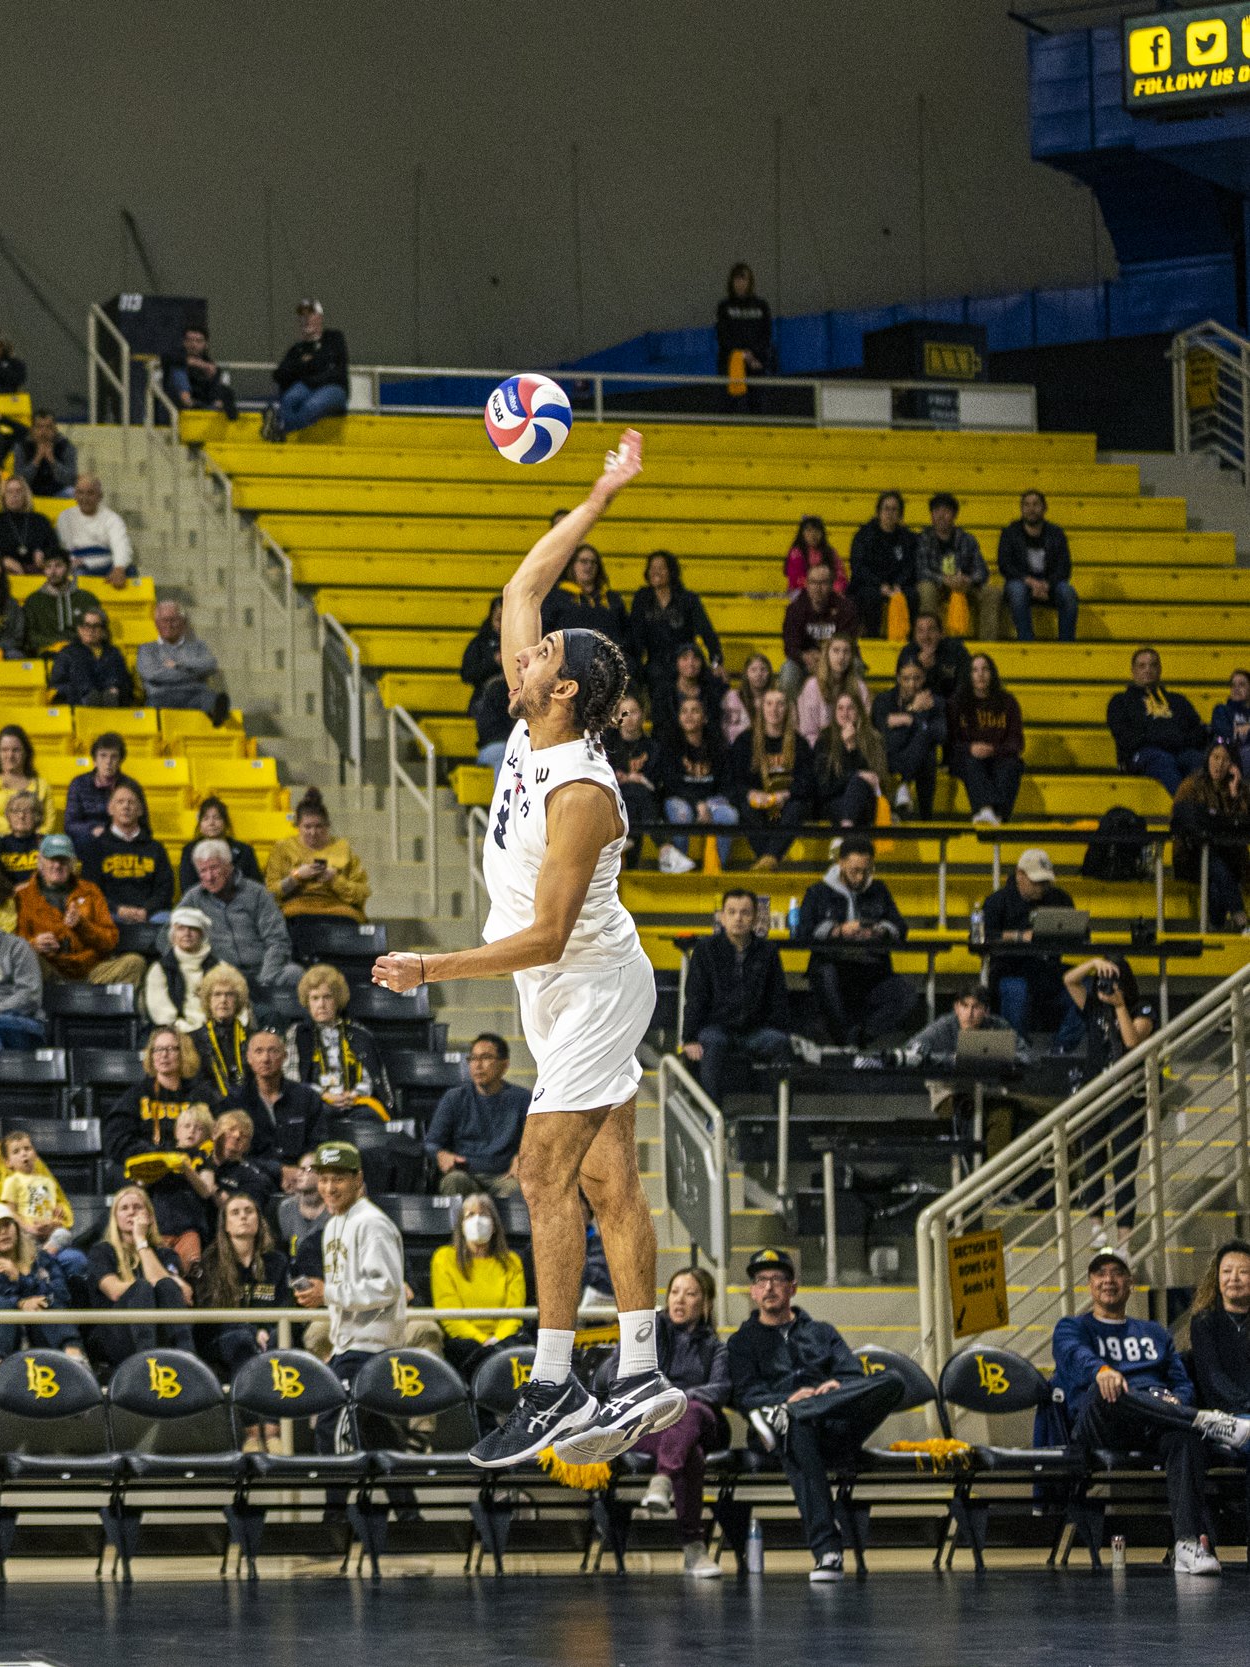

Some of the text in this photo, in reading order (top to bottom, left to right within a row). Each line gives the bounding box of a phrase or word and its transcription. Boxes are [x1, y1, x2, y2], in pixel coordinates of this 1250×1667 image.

[1133, 64, 1250, 97] FOLLOW US O
[493, 393, 504, 422] NCAA
[1096, 1335, 1158, 1361] 1983
[24, 1357, 60, 1399] LB
[146, 1357, 182, 1399] LB
[269, 1357, 305, 1399] LB
[389, 1356, 425, 1399] LB
[975, 1354, 1010, 1396] LB
